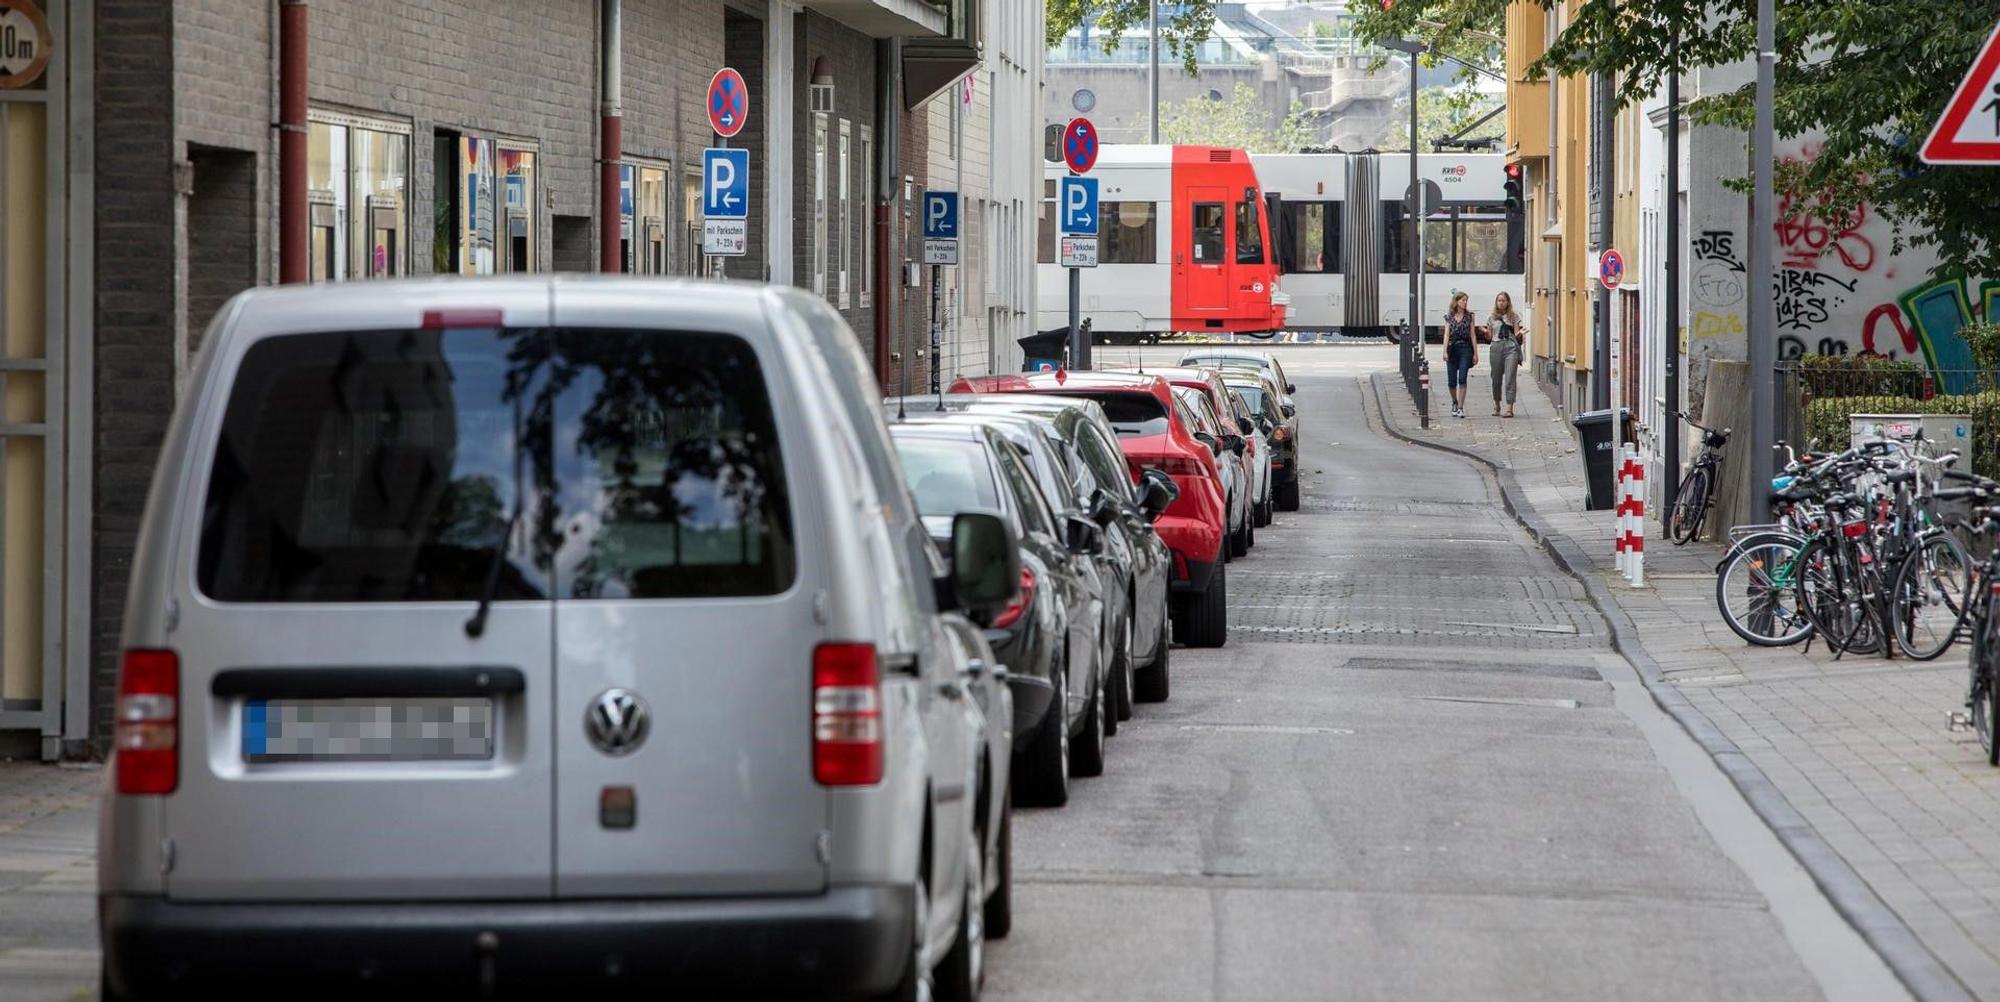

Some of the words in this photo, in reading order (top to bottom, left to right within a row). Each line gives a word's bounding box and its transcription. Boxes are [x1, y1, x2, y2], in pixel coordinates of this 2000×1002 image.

[711, 158, 735, 208] P
[929, 197, 948, 232] P
[1067, 184, 1088, 226] P
[717, 225, 743, 235] Parkschein
[1073, 243, 1095, 252] Parkschein
